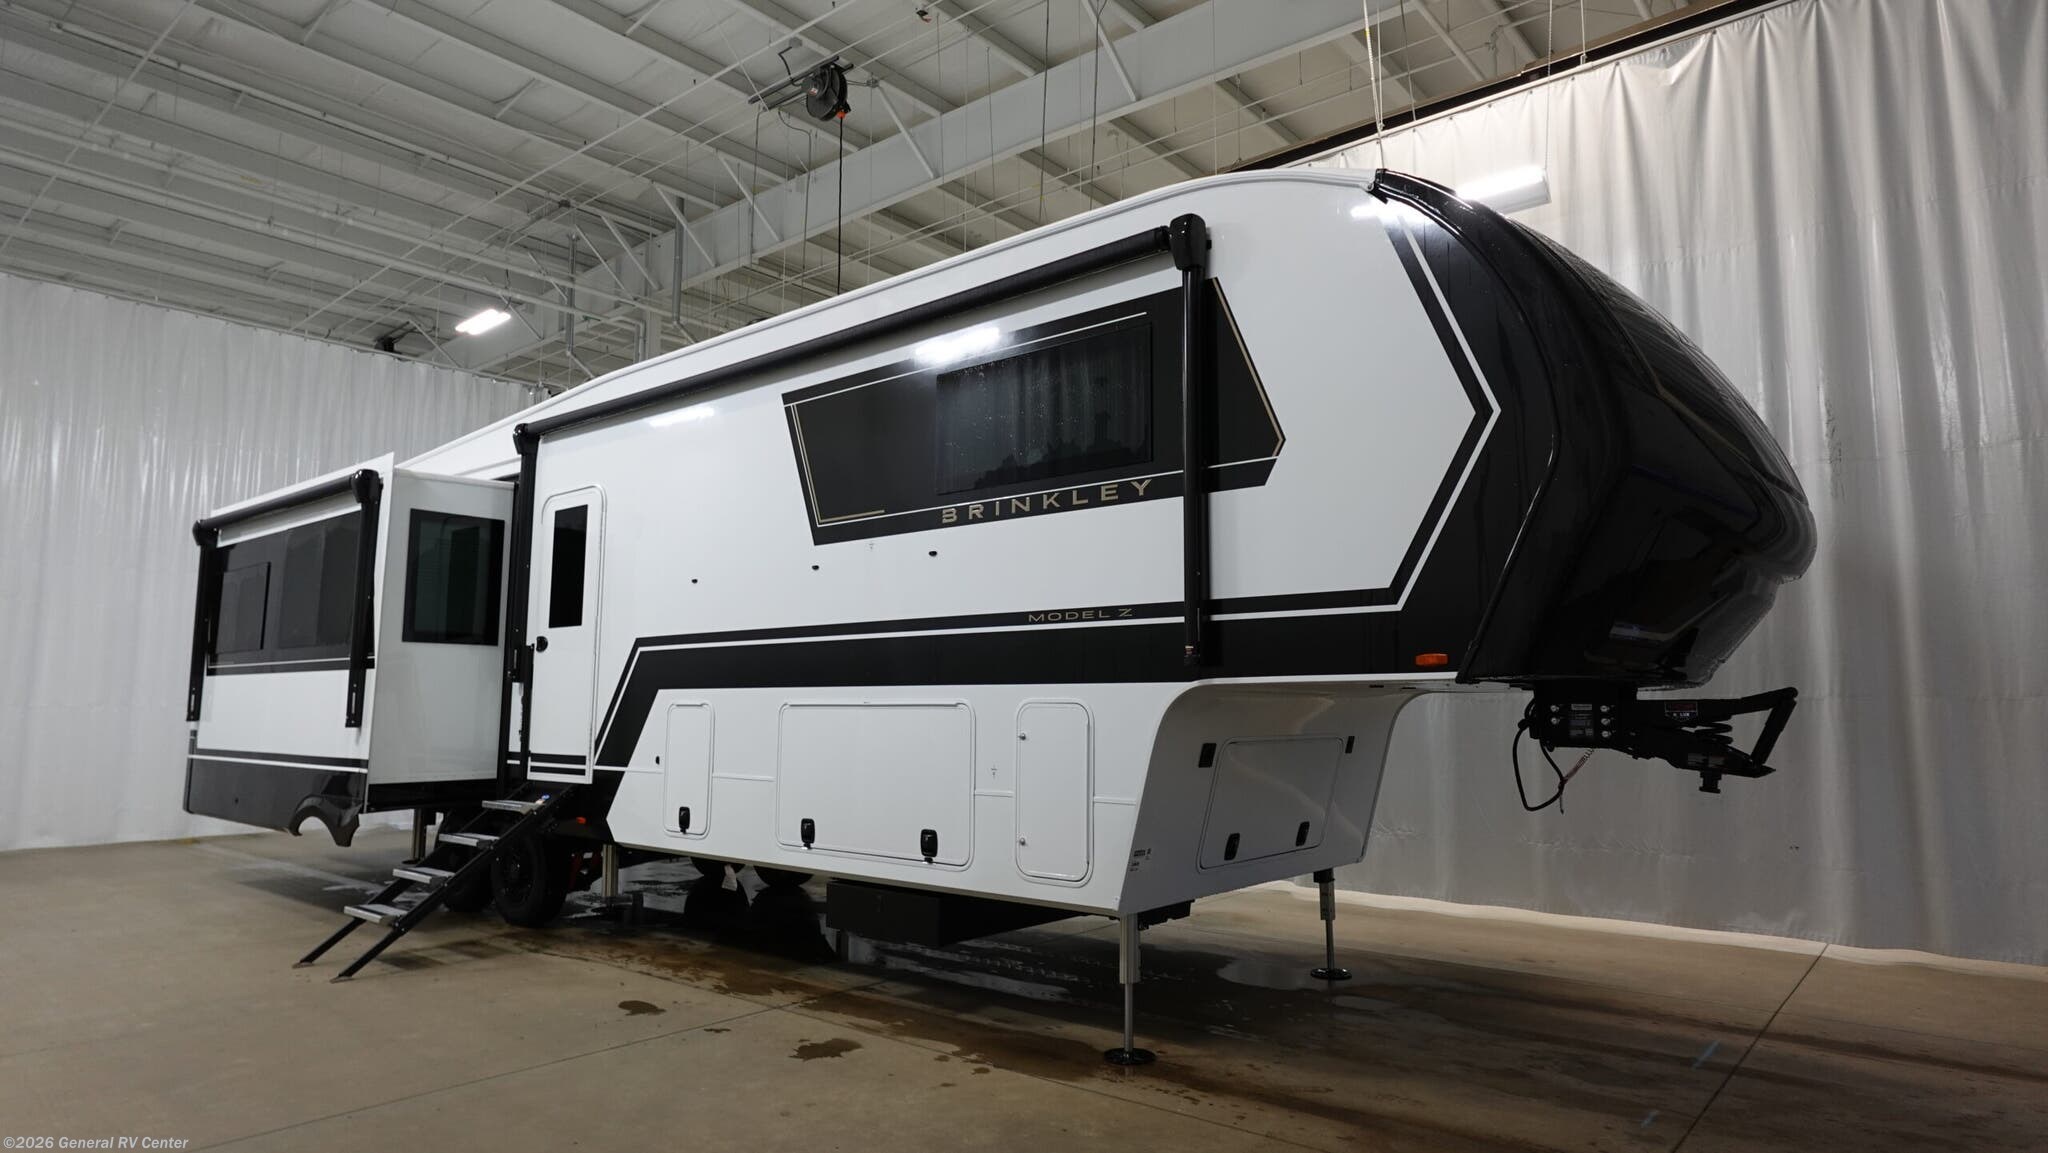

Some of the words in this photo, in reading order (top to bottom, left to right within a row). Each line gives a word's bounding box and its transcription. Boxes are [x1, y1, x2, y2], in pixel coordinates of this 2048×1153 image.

[942, 479, 1152, 524] BRINKLEY
[1028, 609, 1110, 623] MODEL
[1118, 608, 1133, 617] Z
